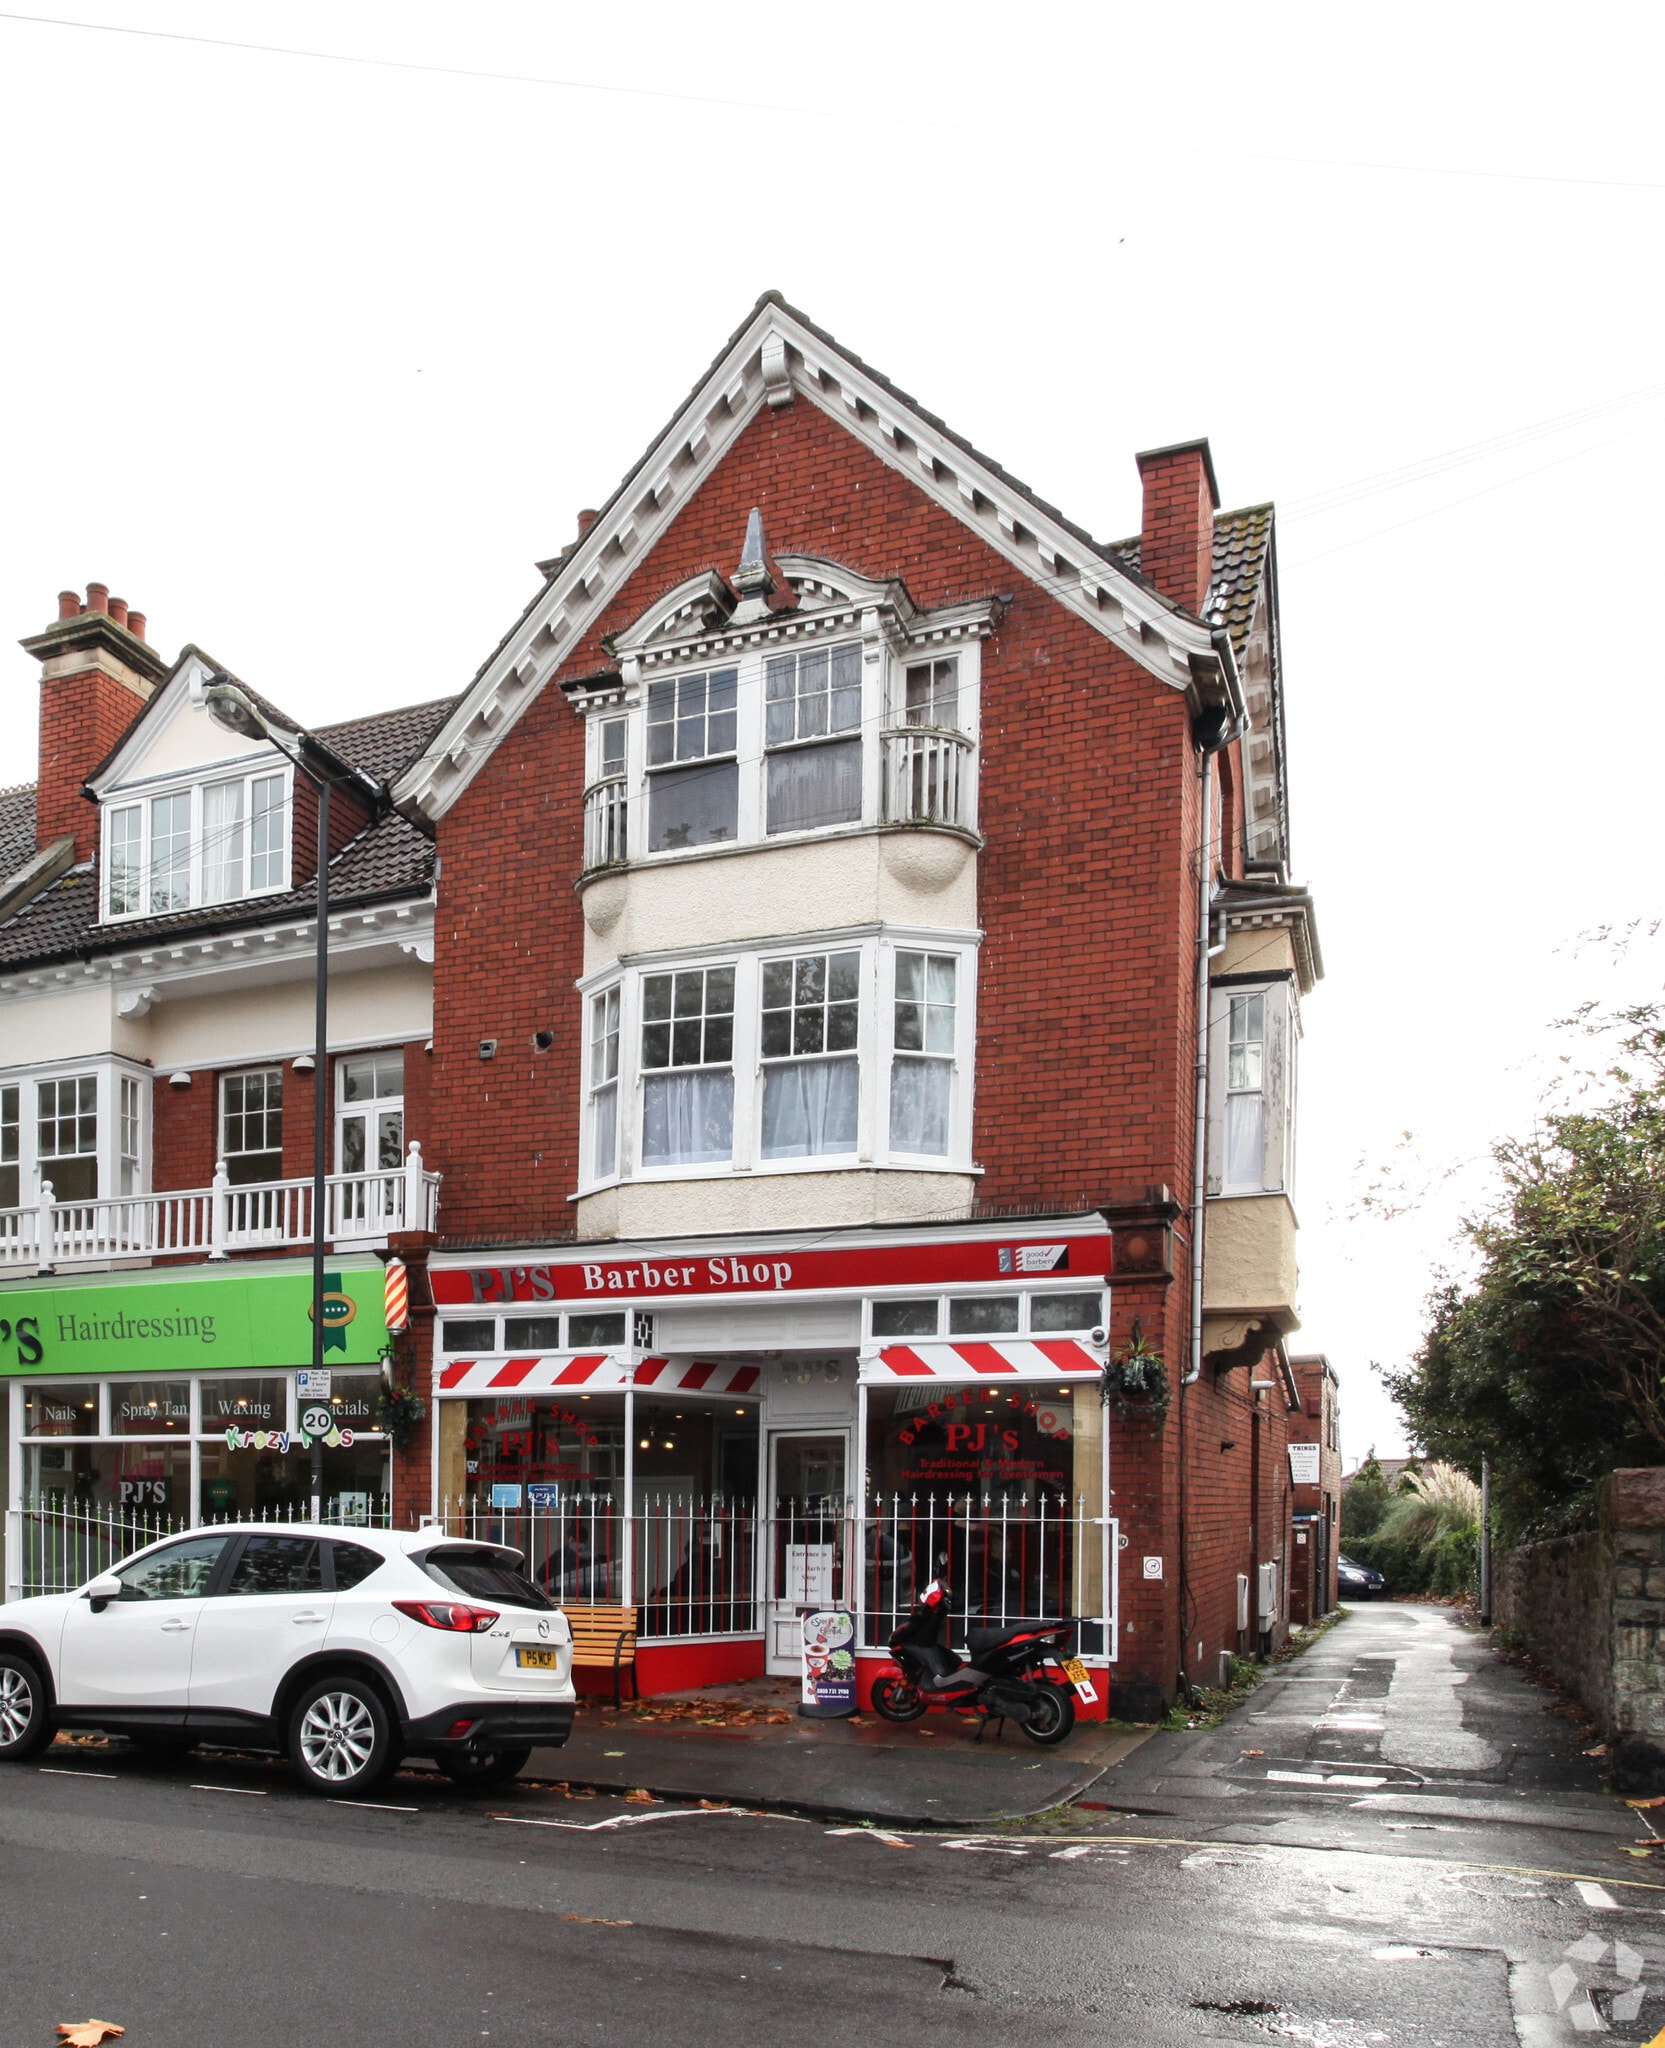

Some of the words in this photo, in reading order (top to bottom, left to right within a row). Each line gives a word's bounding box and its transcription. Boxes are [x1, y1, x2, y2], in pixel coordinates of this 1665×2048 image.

[1026, 1251, 1044, 1259] good
[467, 1265, 555, 1303] PJ'S
[581, 1262, 696, 1291] Barber
[708, 1257, 792, 1290] Shop
[56, 1308, 216, 1344] Hairdressing
[45, 1405, 77, 1421] Nails
[121, 1402, 158, 1420] Spray
[162, 1401, 188, 1416] Tan
[219, 1400, 272, 1419] Waxing
[326, 1399, 370, 1416] acials
[899, 1387, 992, 1446] BARBER
[1009, 1393, 1070, 1441] SHOP
[305, 1413, 330, 1428] 20
[549, 1402, 599, 1447] SHOP
[225, 1425, 290, 1454] Krazy
[500, 1431, 560, 1456] PJ's
[945, 1423, 1019, 1451] PJ's
[919, 1459, 980, 1468] Traditional
[984, 1458, 993, 1468] &
[902, 1470, 973, 1481] Hairdressing
[978, 1470, 994, 1479] for
[1000, 1470, 1064, 1480] Gentlemen
[119, 1481, 166, 1503] PJ'S
[1080, 1684, 1092, 1698] L
